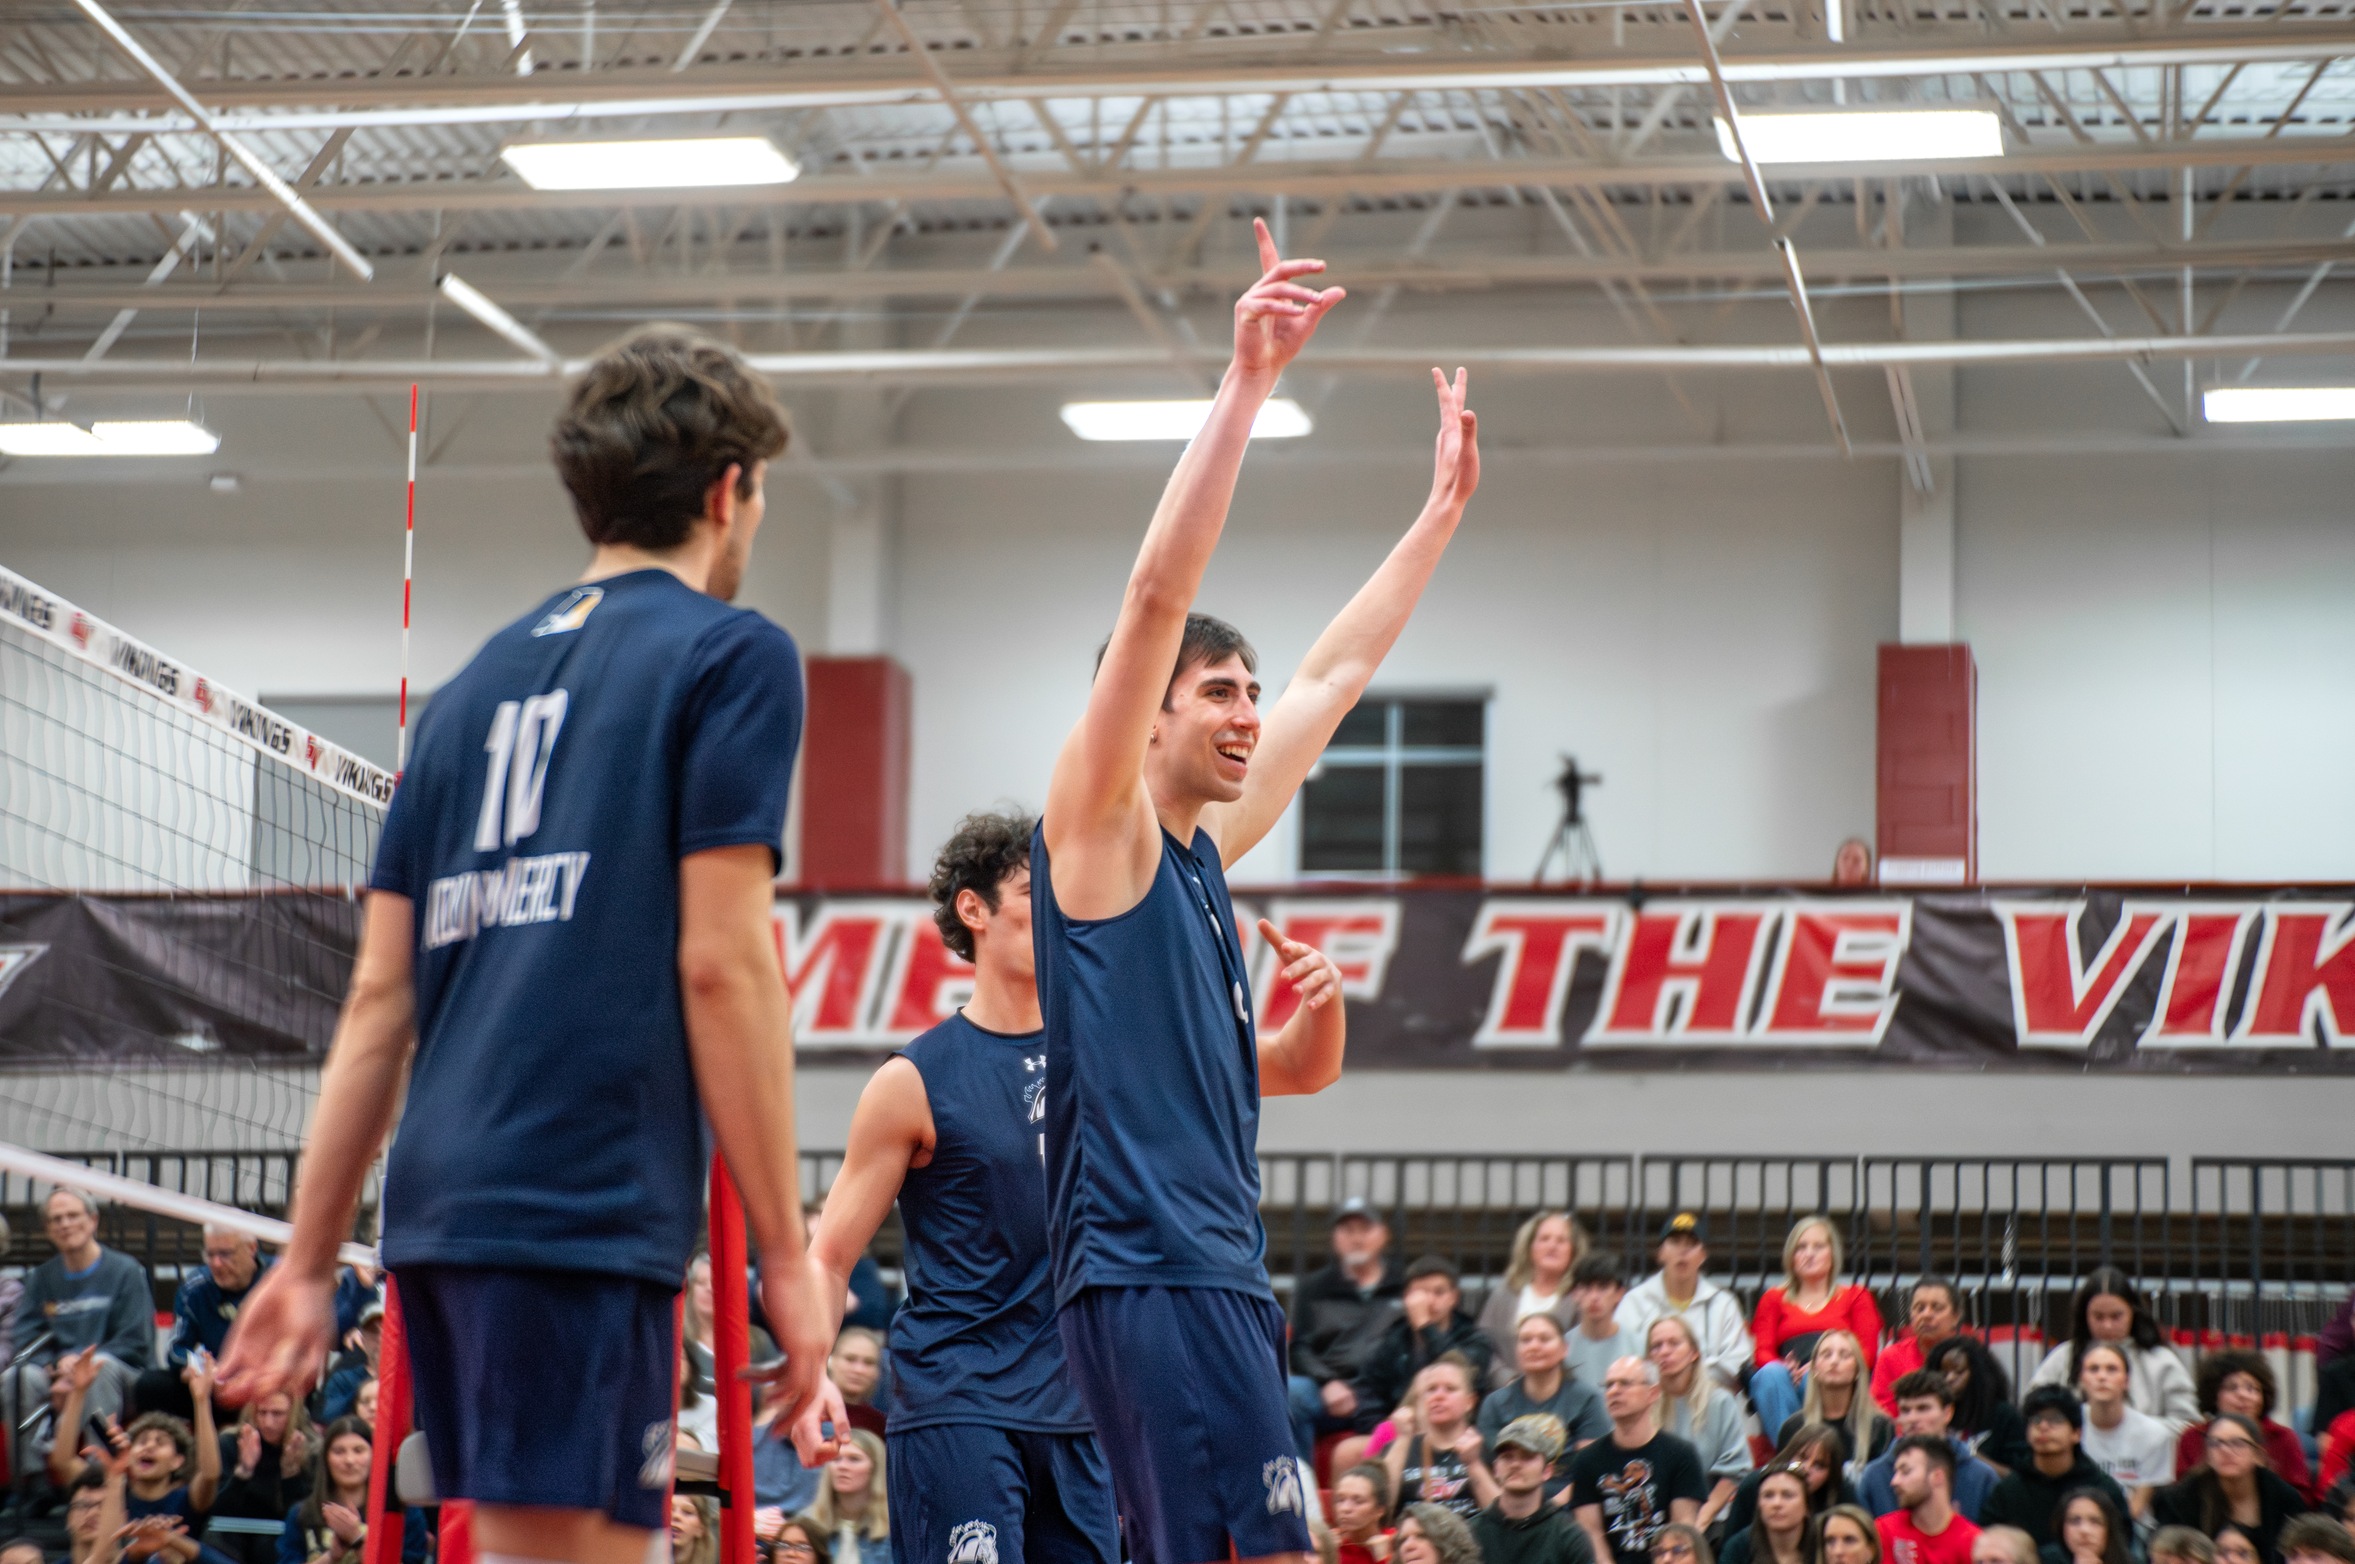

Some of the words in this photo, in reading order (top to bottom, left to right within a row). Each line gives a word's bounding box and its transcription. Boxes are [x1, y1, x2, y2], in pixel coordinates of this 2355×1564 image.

[109, 634, 179, 696] VIKINGS
[229, 699, 291, 755] VIKINGS
[335, 754, 393, 804] VIKINGS
[473, 688, 568, 852] 10
[1461, 900, 1912, 1048] THE
